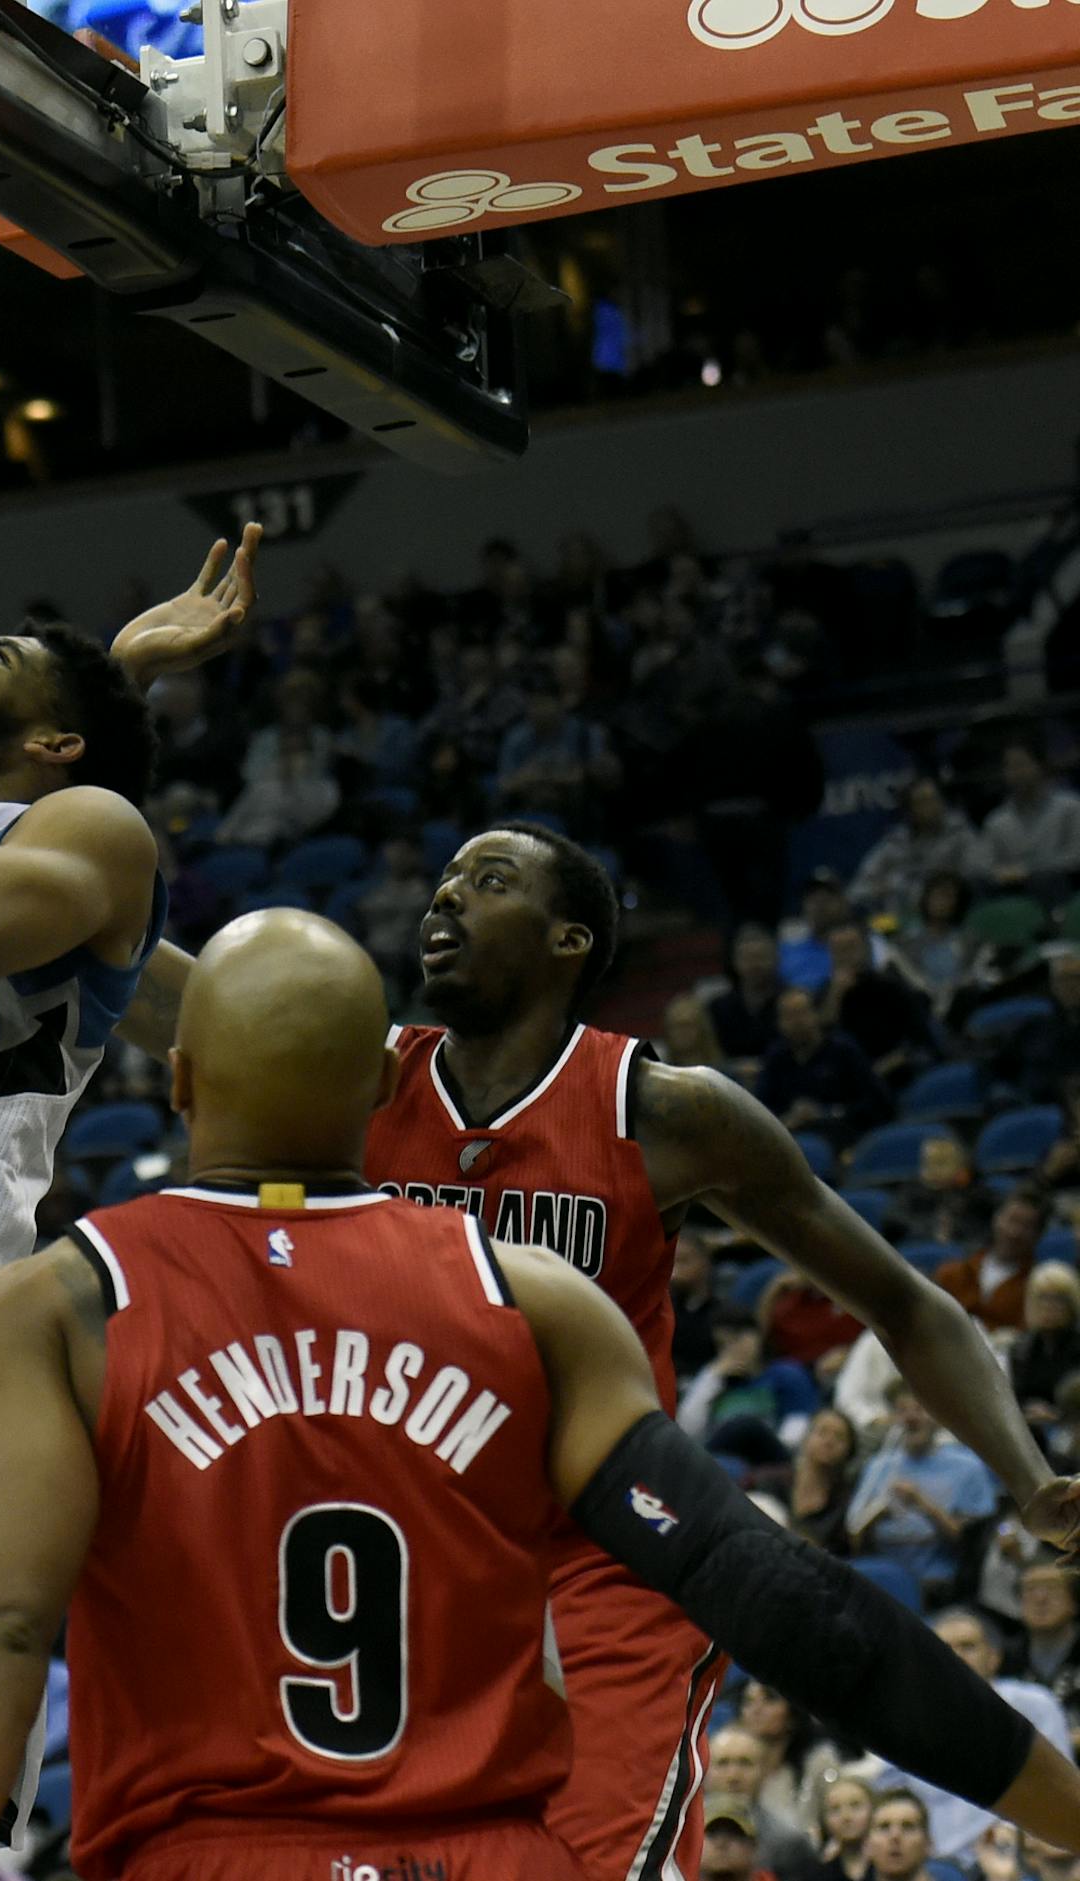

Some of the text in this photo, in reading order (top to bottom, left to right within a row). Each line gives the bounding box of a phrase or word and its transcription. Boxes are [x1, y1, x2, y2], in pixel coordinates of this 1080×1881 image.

[587, 110, 952, 194] State
[144, 1329, 512, 1475] HENDERSON
[278, 1502, 409, 1761] 9
